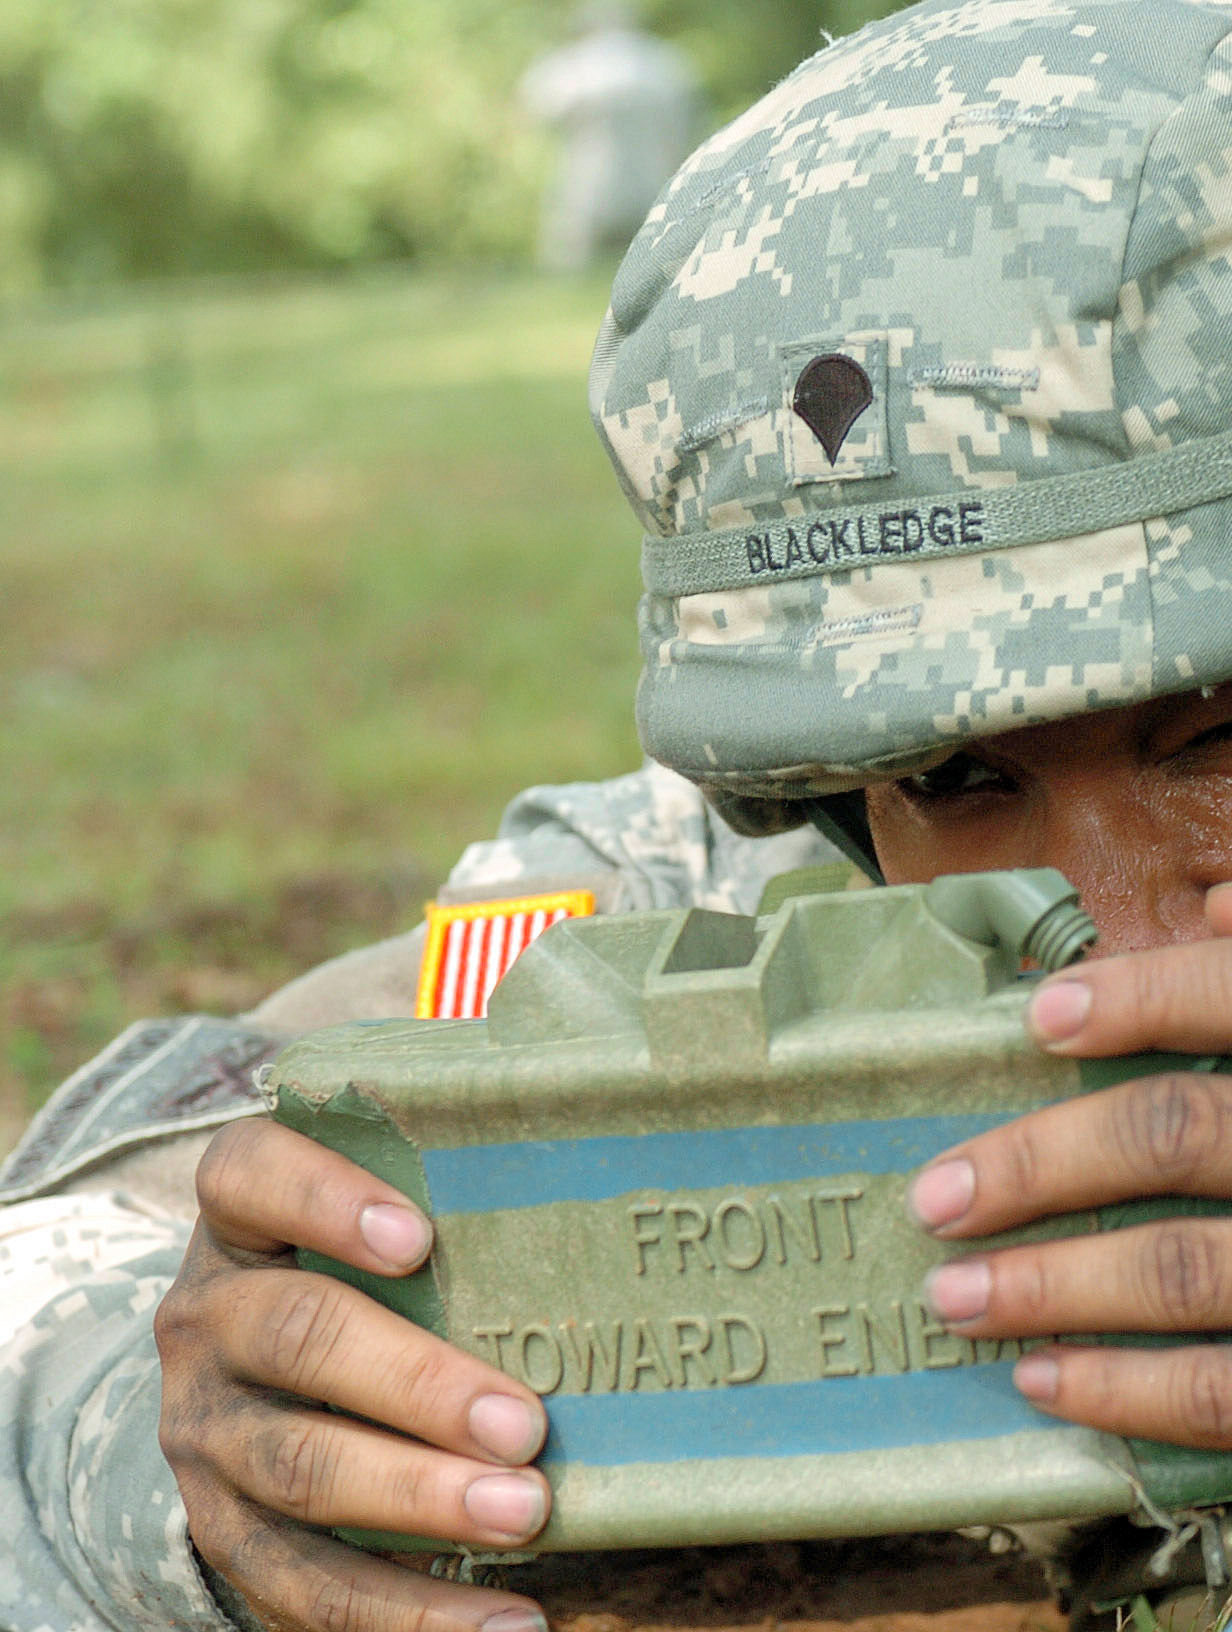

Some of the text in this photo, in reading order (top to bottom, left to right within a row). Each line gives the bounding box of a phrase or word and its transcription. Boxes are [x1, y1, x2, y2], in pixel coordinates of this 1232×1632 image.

[746, 502, 984, 574] BLACKLEDGE
[630, 1186, 865, 1276] FRONT
[472, 1299, 1058, 1396] TOWARD ENE
